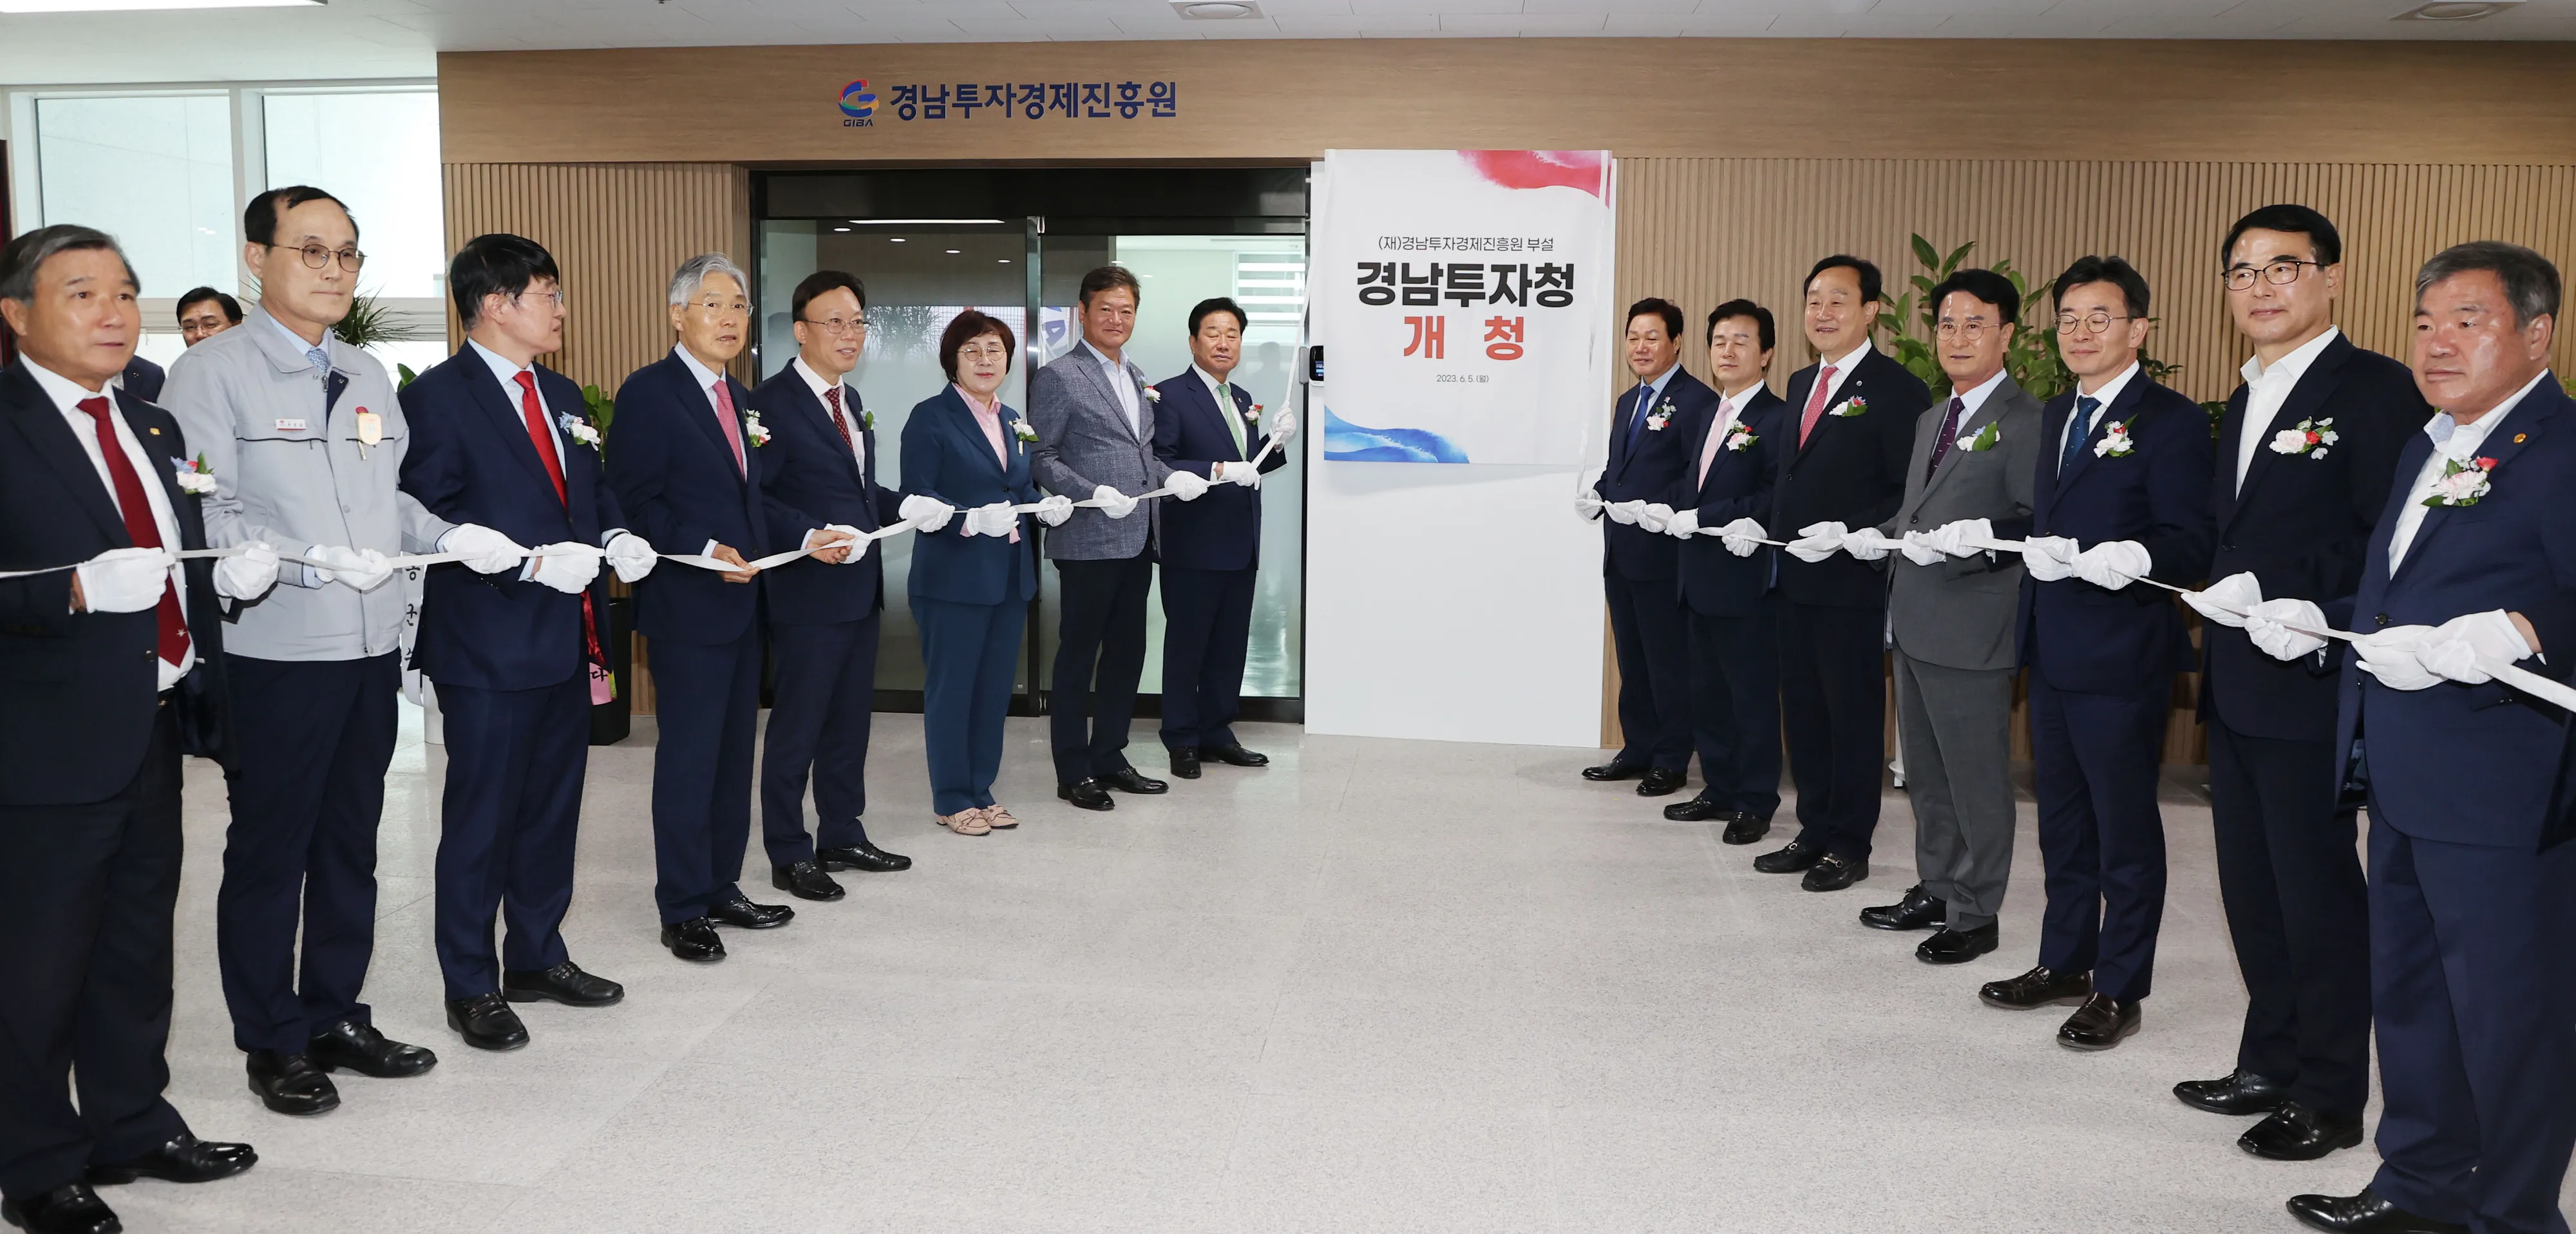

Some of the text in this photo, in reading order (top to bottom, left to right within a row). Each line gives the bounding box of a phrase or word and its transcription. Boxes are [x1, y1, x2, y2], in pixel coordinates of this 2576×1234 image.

[890, 81, 1177, 121] 경남투자경제진흥원
[843, 119, 873, 127] GIBA
[1378, 236, 1554, 252] (재)경남투자경제진흥원 부설
[1357, 261, 1575, 308] 경남투자청
[1436, 374, 1458, 383] 2023.
[1476, 375, 1490, 383] (월)
